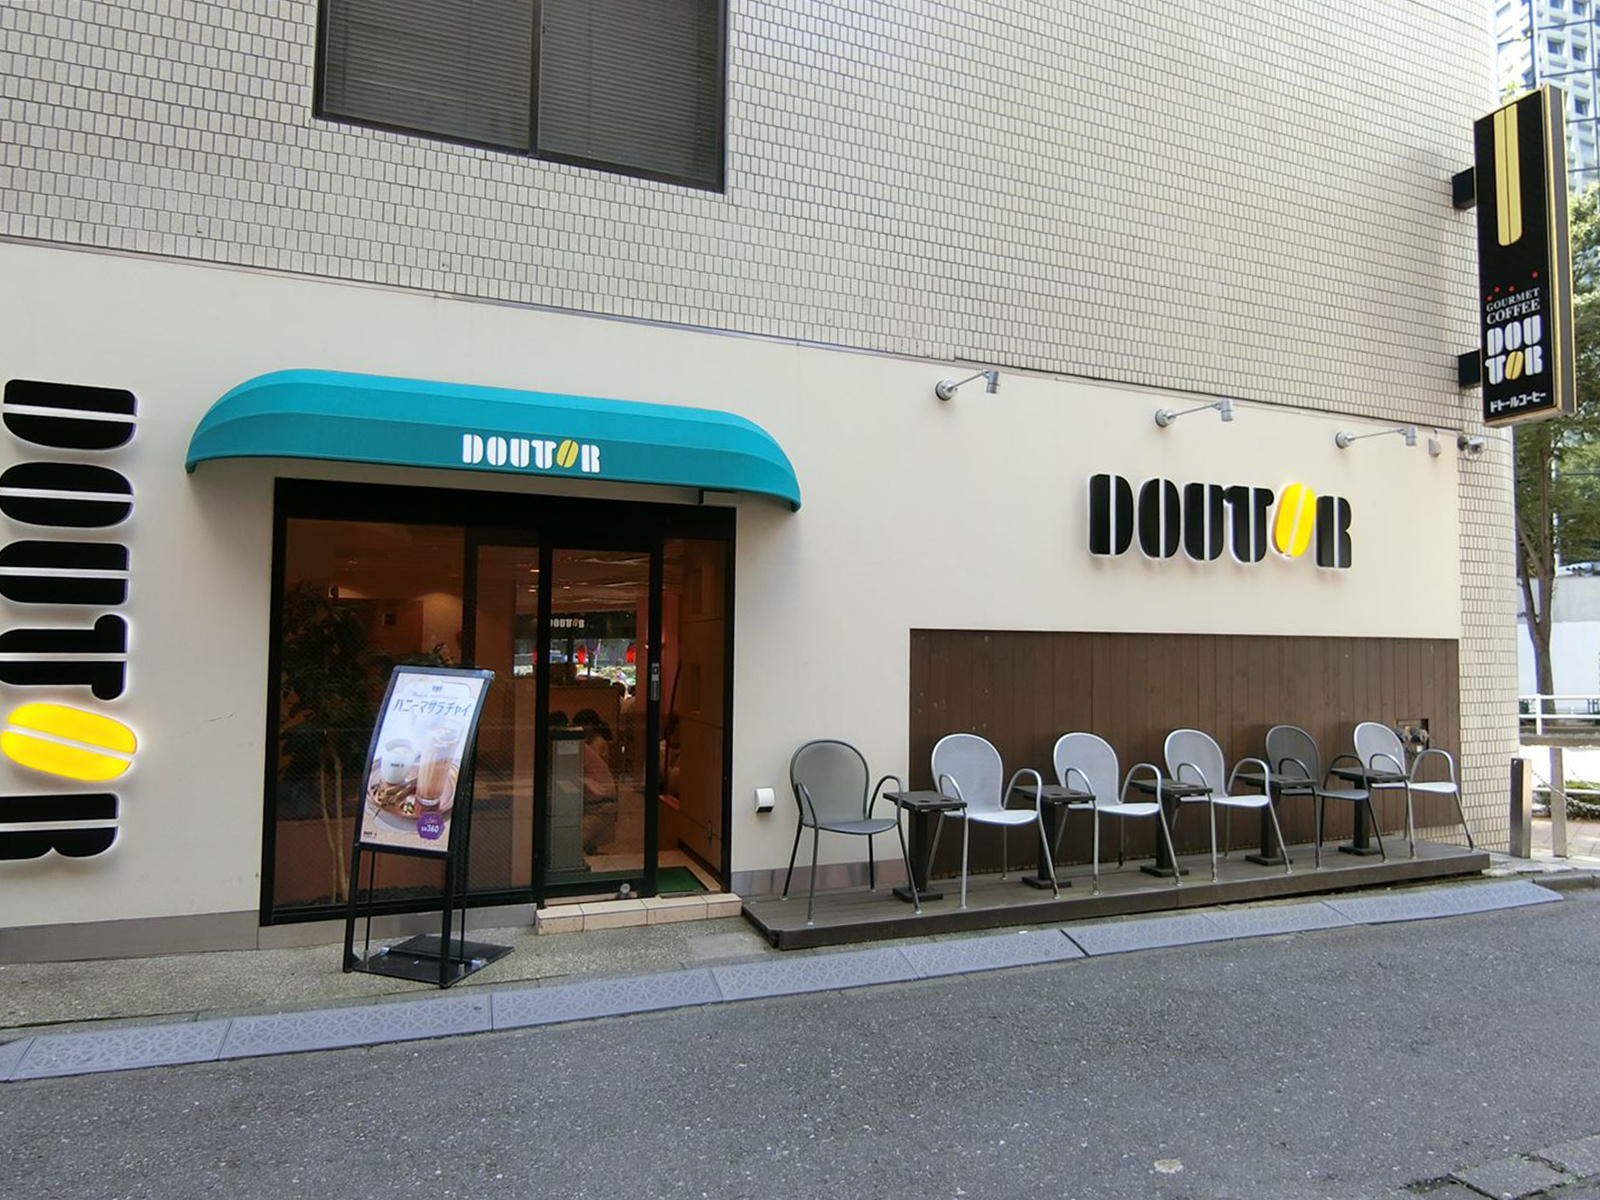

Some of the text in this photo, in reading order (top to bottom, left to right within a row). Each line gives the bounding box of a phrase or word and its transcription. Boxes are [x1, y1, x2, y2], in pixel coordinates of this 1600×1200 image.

[1486, 287, 1540, 312] GOURMET
[1486, 298, 1541, 325] COFFEE
[1487, 314, 1541, 357] DOU
[1484, 345, 1543, 385] TOR
[1490, 391, 1547, 413] ドトールコーヒー
[462, 434, 600, 473] DOUTOR
[1089, 473, 1352, 568] DOUTOR
[0, 379, 137, 860] DOUTOR
[393, 698, 472, 717] ハニーマサラチャイ
